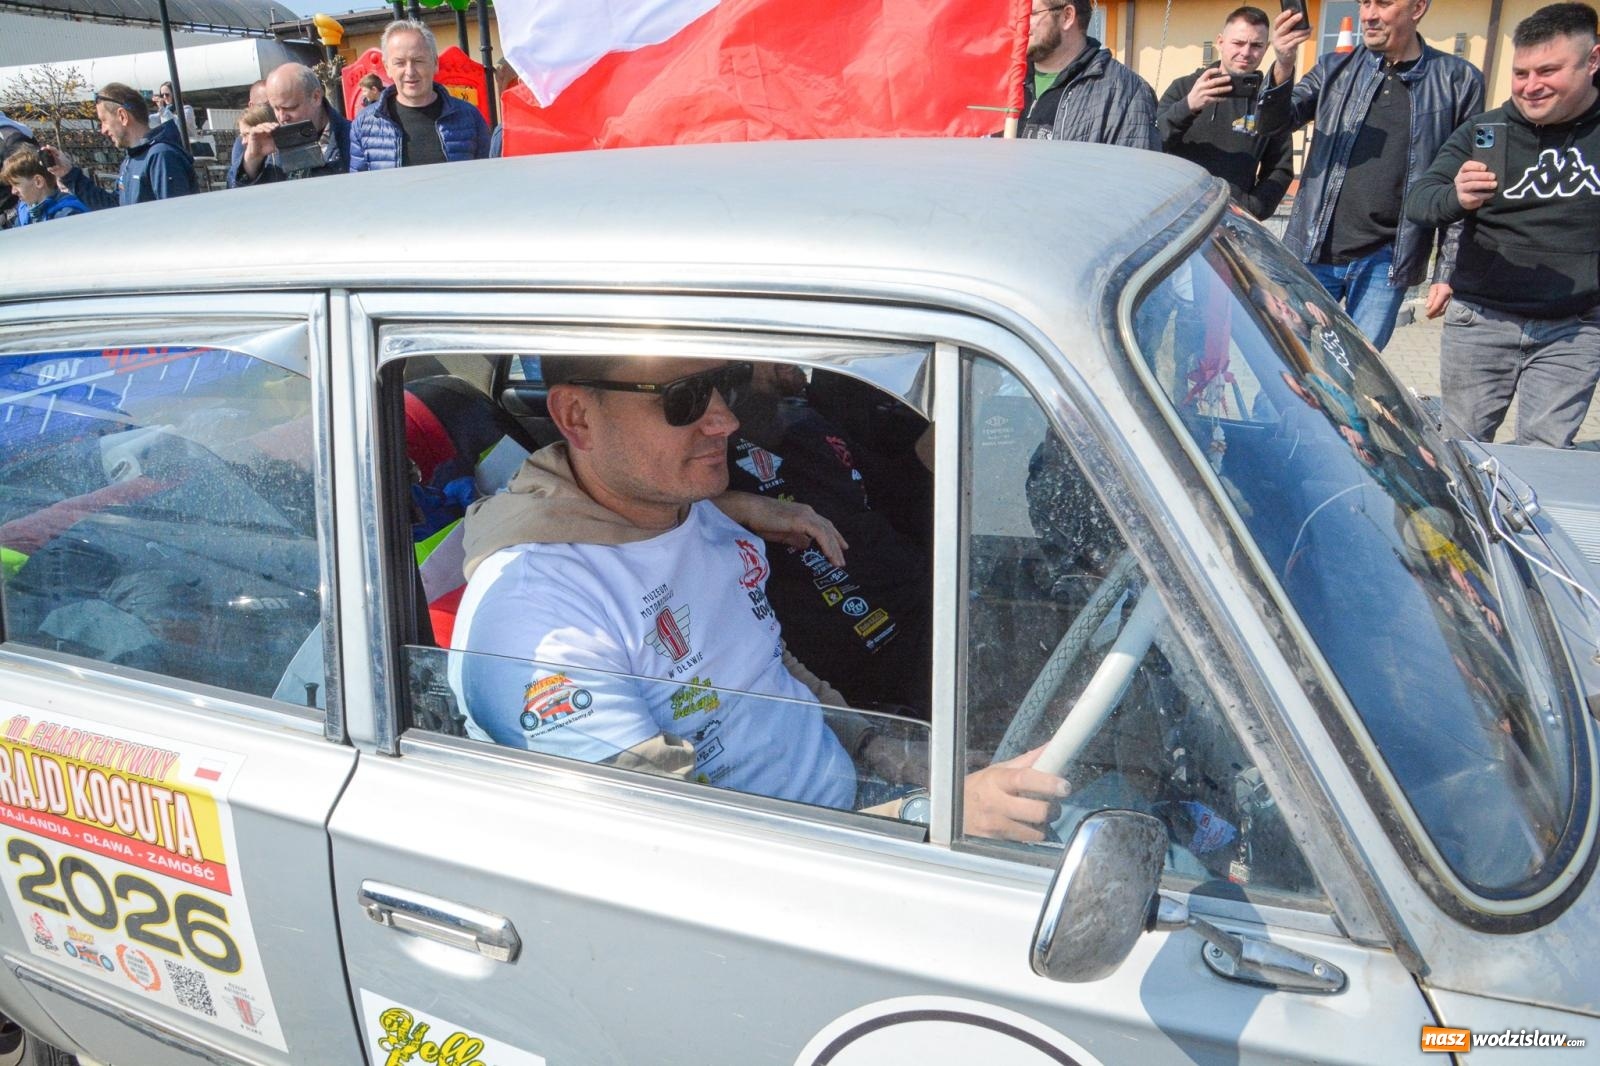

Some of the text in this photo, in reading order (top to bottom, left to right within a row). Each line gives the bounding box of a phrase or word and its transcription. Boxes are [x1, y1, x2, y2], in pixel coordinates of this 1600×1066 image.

[642, 583, 669, 604] MUZEUM
[676, 651, 704, 674] OŁAWIE
[30, 720, 180, 782] CHARYTATYWNY
[0, 744, 205, 863] RAJD KOGUTA
[0, 806, 72, 838] TAJLANDIA
[83, 831, 134, 857] OŁAWA
[147, 850, 216, 881] ZAMOŚĆ
[7, 837, 243, 977] 2026
